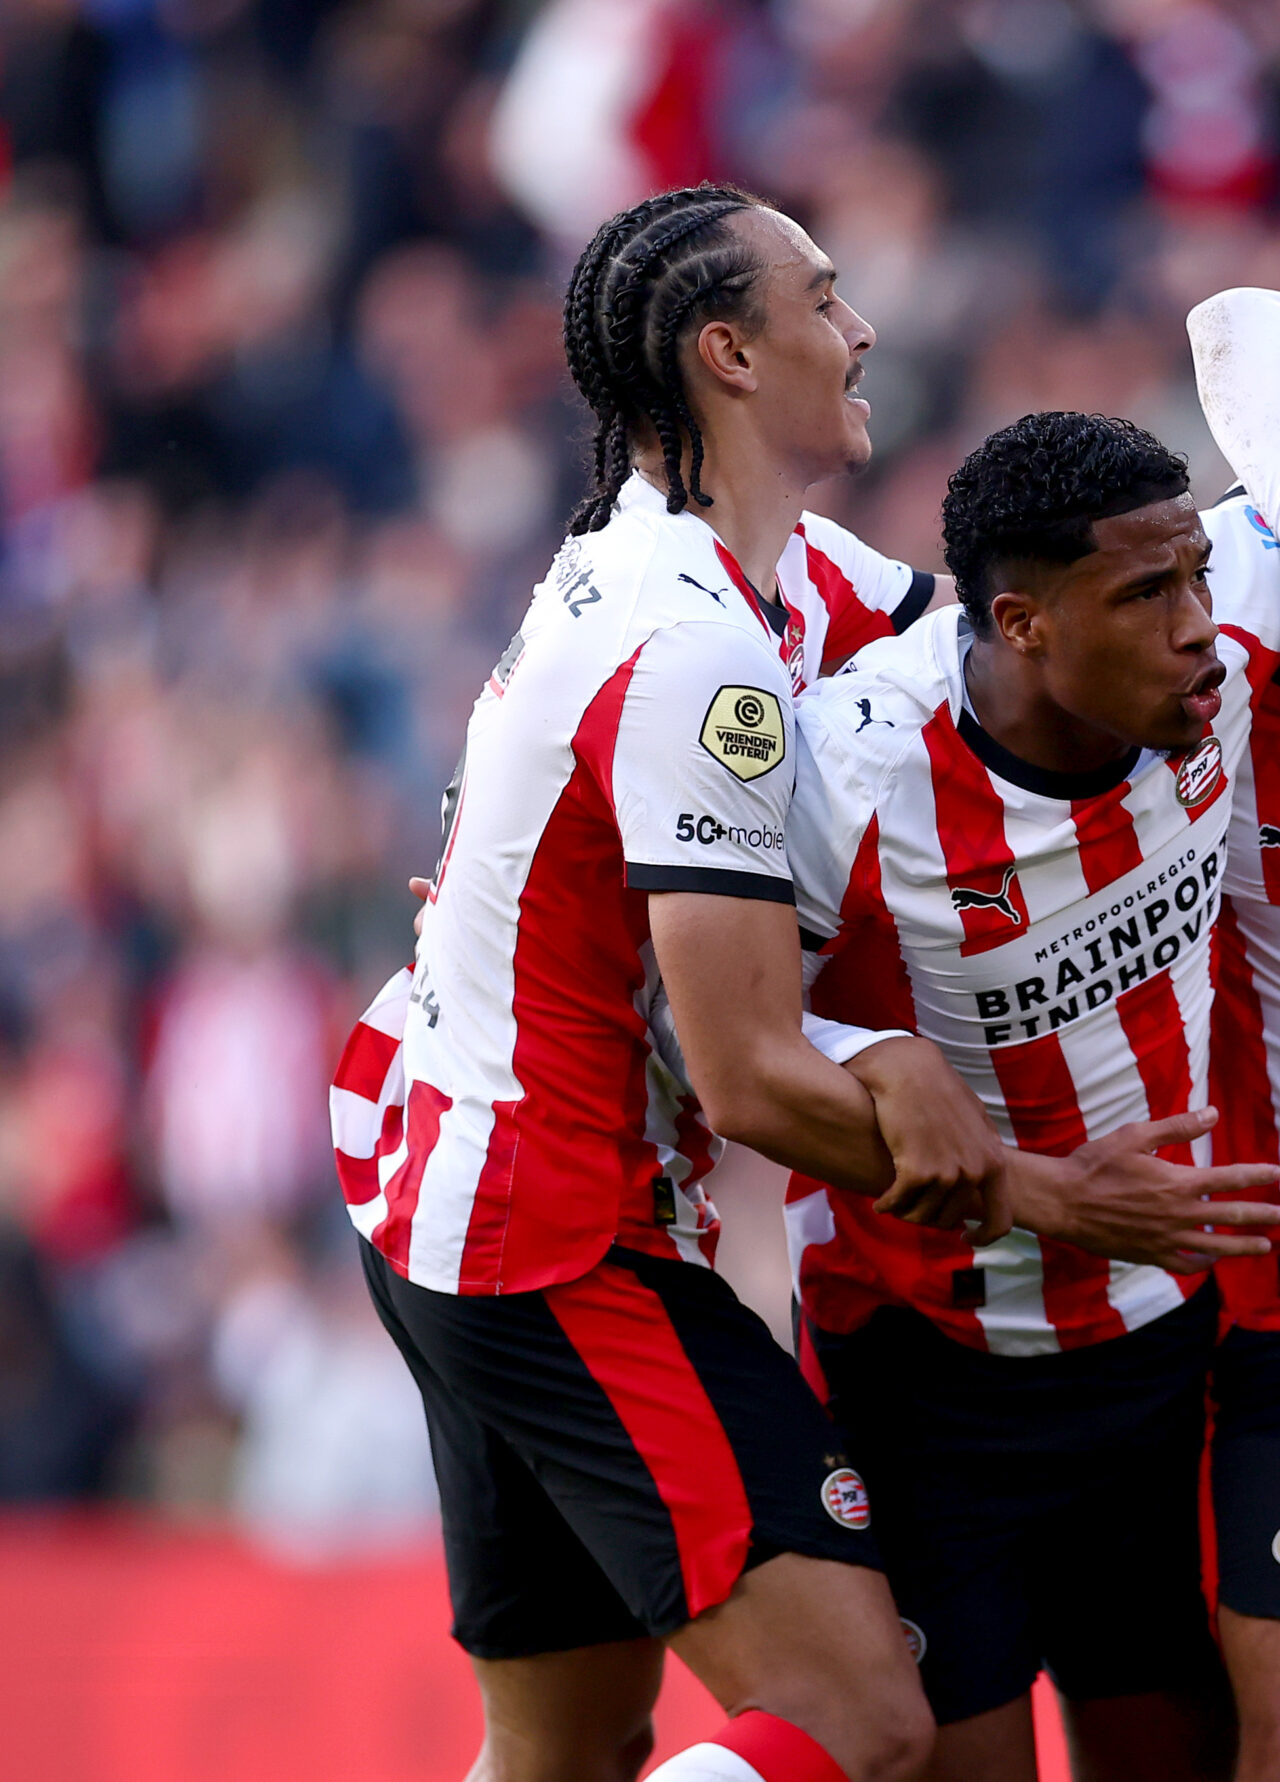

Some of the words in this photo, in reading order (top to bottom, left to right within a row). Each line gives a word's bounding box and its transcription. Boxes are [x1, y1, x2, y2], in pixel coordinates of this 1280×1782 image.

[716, 731, 776, 752] VRIENDEN
[723, 743, 769, 762] LOTERIJ
[1191, 757, 1207, 782] PSV
[1035, 849, 1195, 963] METROPOOLREGIO
[985, 888, 1217, 1045] EINDHOVE
